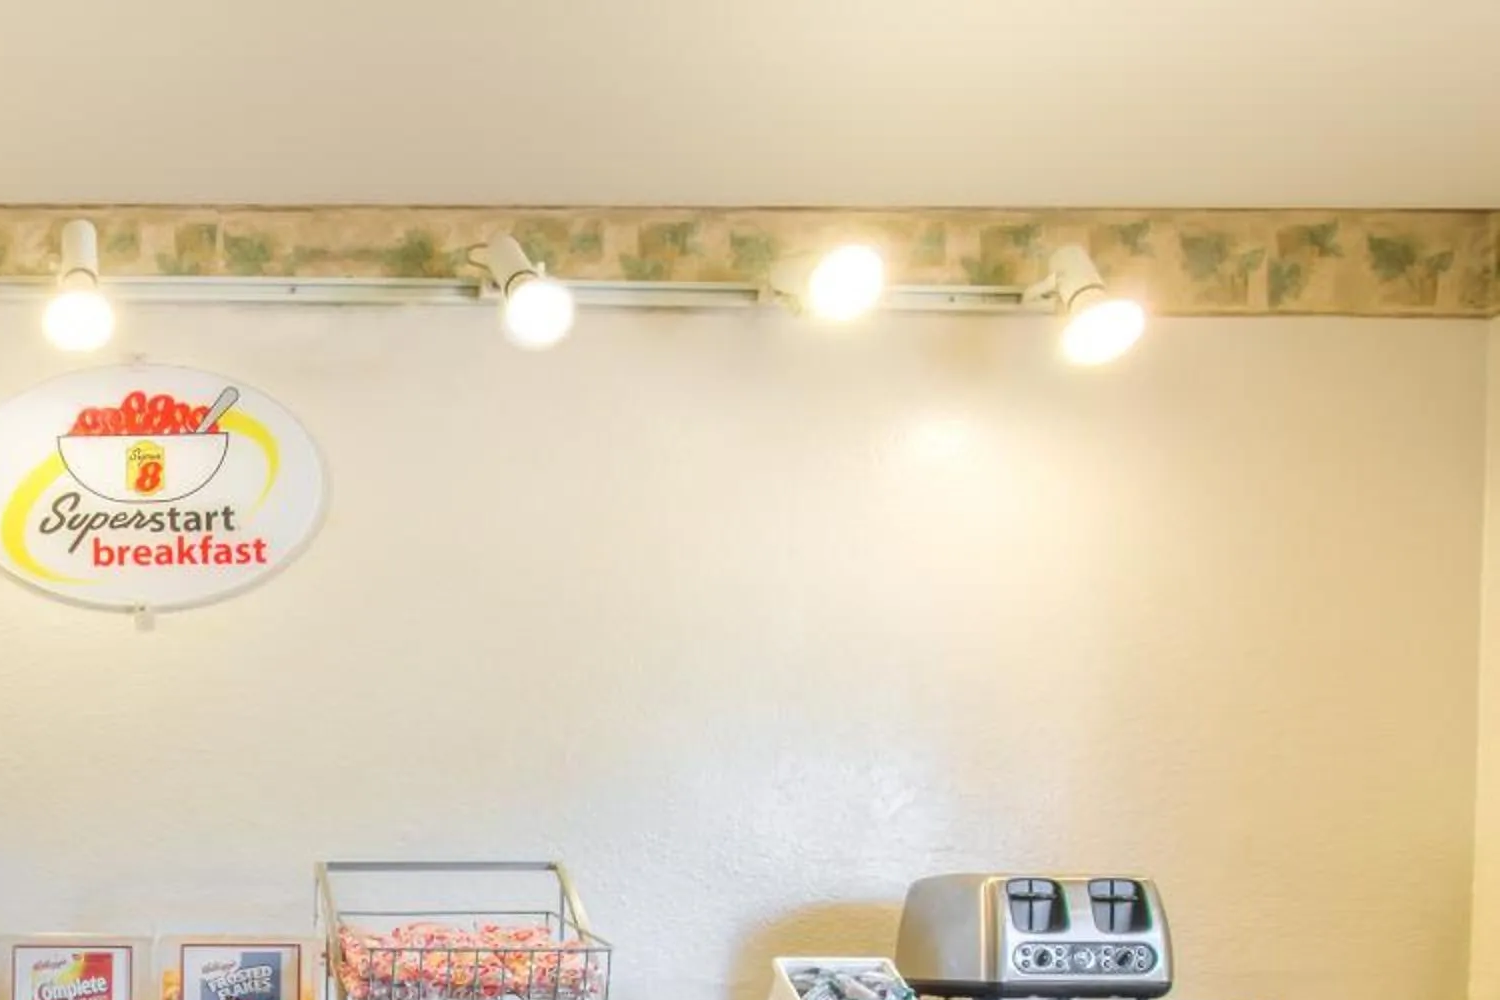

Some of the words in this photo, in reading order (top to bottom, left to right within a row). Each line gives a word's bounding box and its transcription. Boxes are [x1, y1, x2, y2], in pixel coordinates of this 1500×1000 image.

[135, 461, 163, 492] 8
[92, 536, 268, 567] breakfast
[207, 965, 273, 993] FROSTED
